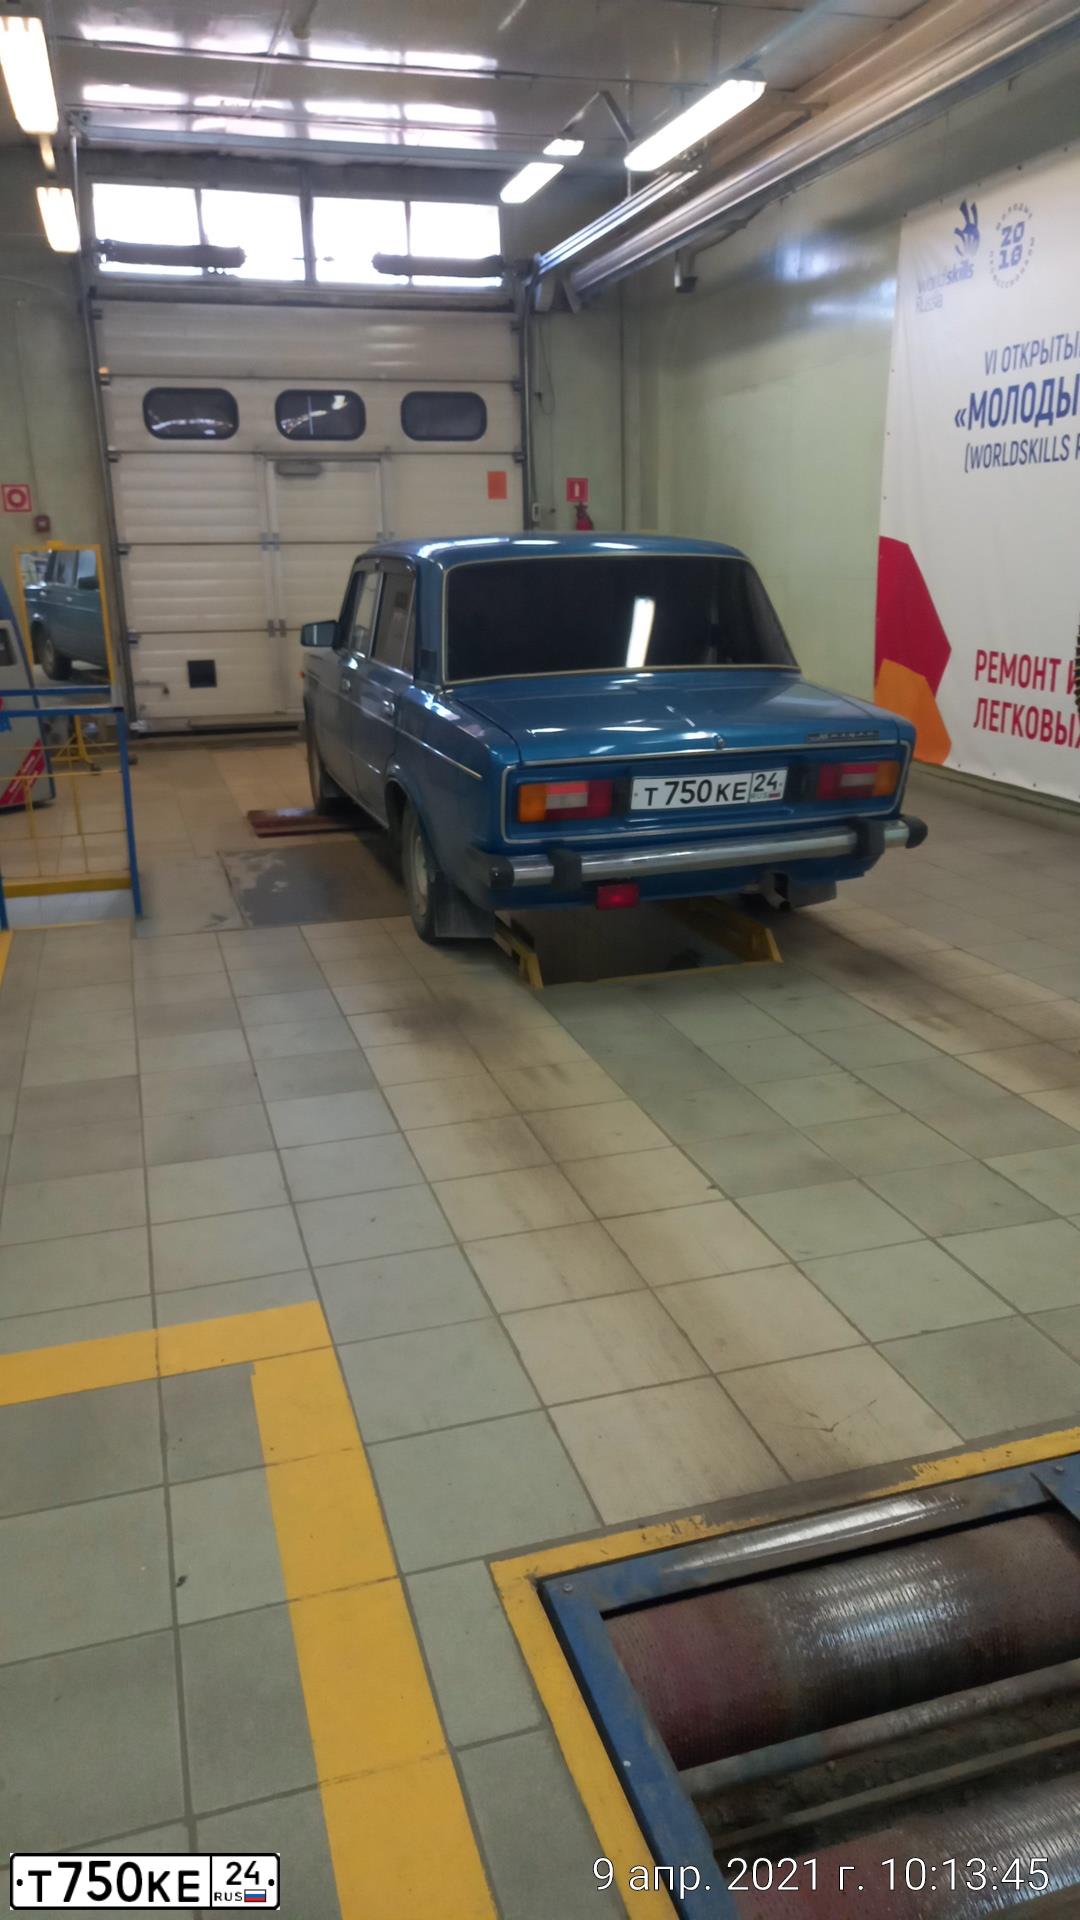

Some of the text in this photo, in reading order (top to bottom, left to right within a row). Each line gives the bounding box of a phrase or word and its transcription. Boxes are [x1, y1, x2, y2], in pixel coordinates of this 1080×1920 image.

[1001, 221, 1025, 248] 20
[998, 243, 1023, 270] 18
[984, 330, 1080, 376] VI ОТКРЫТЫ
[974, 648, 1062, 693] РЕМОНТ
[753, 772, 778, 793] 24
